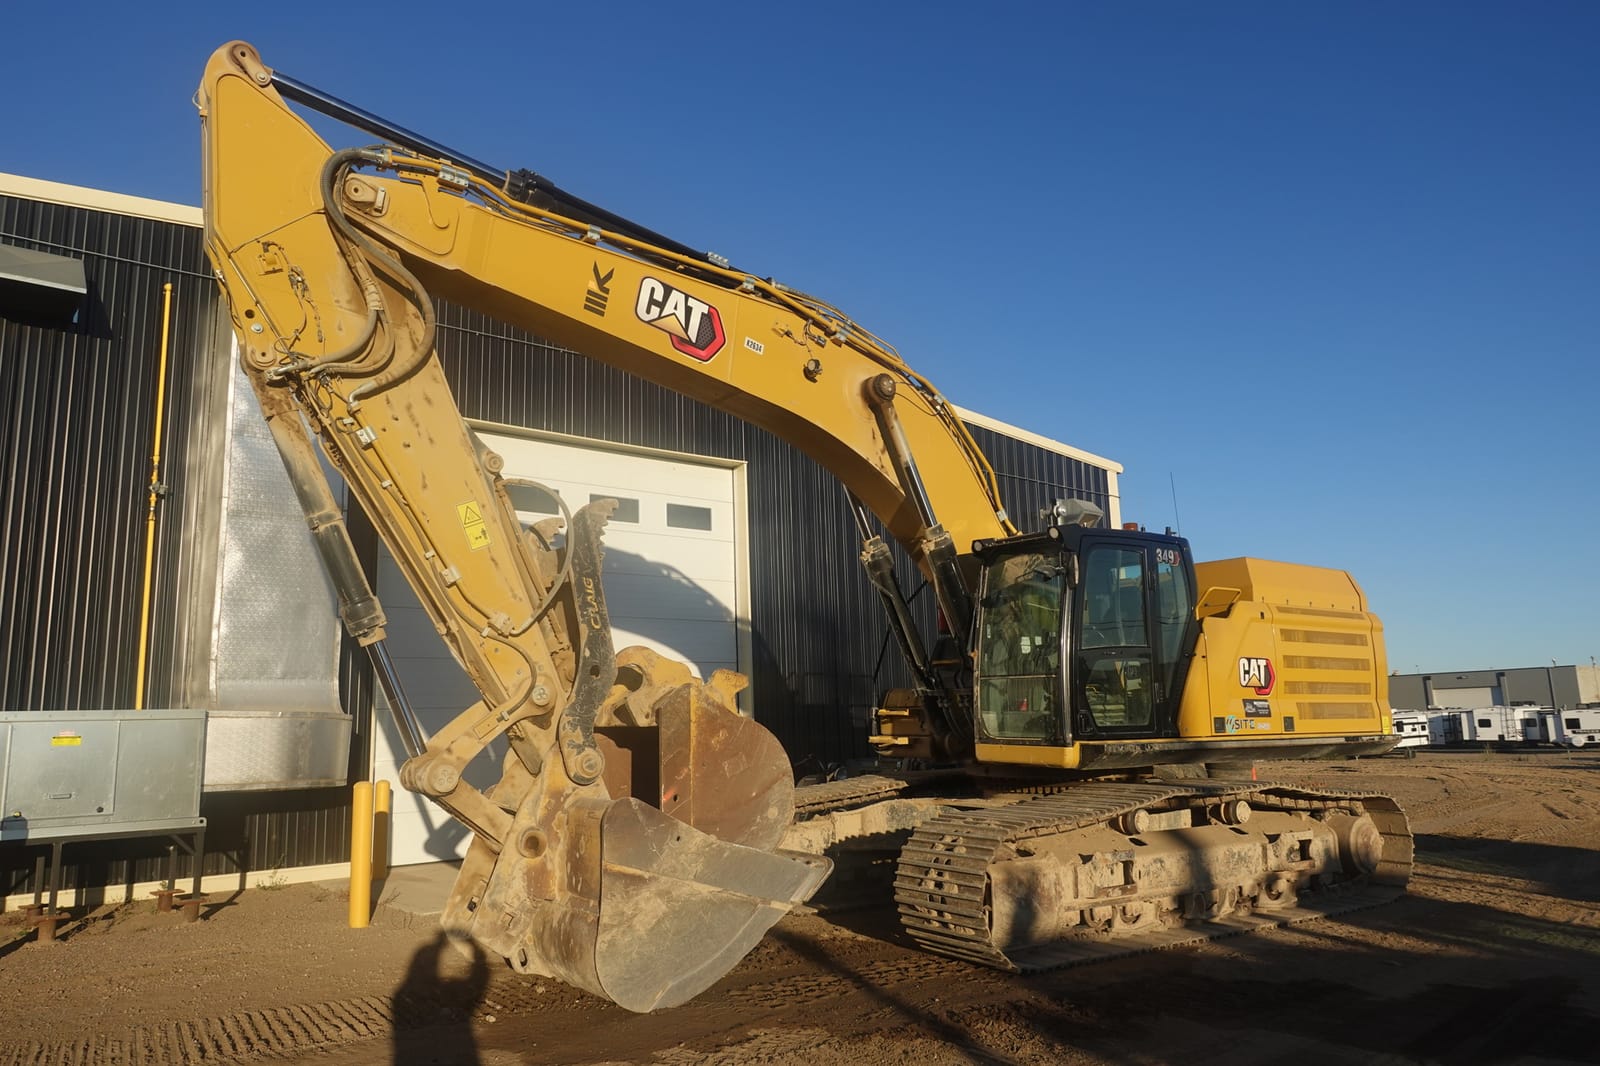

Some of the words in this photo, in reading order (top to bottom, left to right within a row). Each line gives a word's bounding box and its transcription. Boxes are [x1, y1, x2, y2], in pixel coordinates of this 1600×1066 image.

[636, 277, 710, 344] CAT
[1156, 548, 1174, 564] 349
[583, 576, 602, 630] CRAIG
[1239, 657, 1267, 687] CAT
